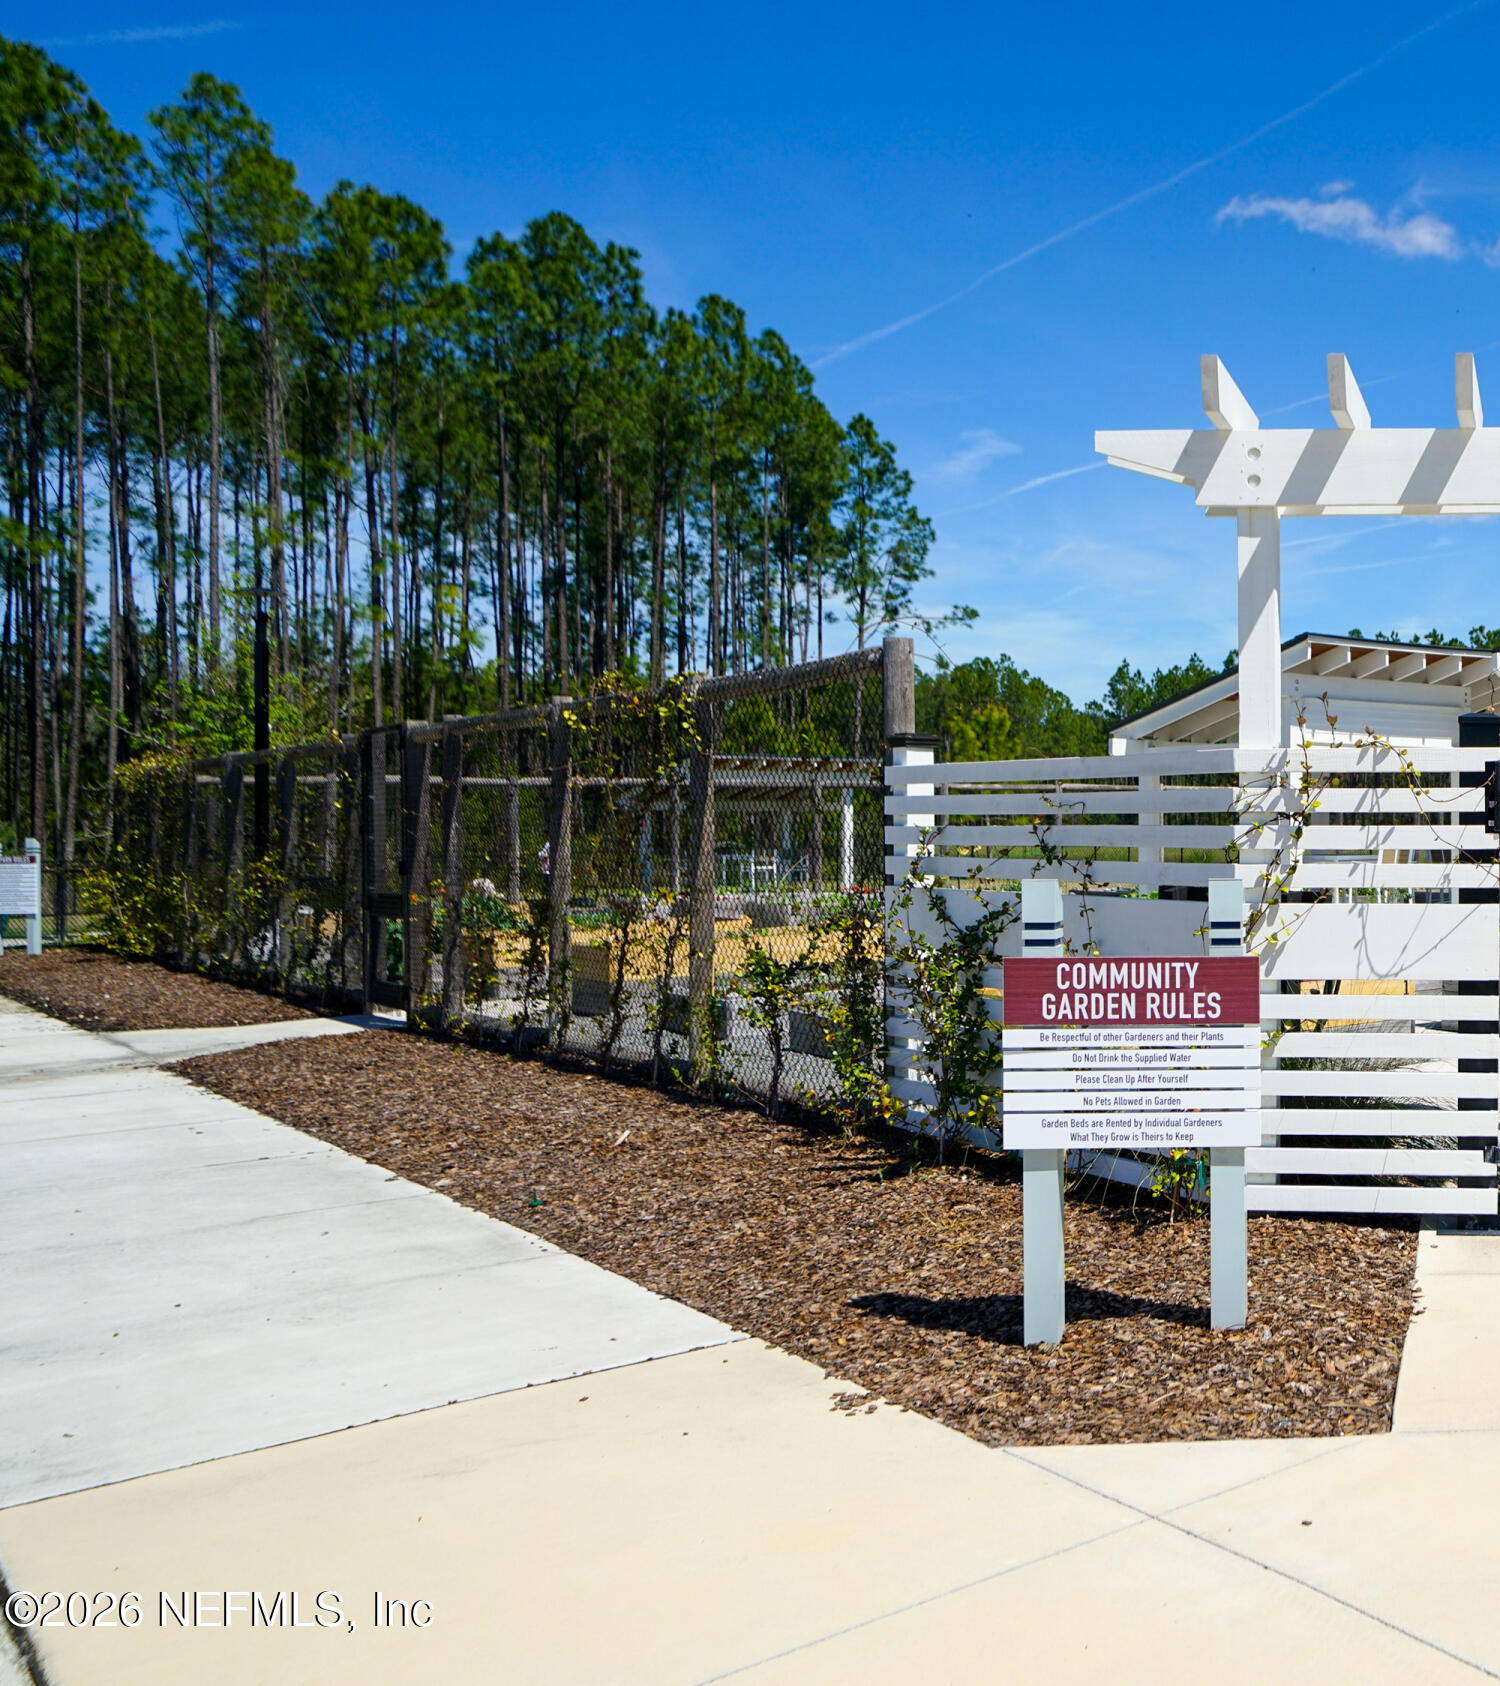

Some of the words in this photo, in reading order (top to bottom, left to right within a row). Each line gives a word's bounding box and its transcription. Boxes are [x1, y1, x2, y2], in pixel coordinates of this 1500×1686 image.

[1056, 962, 1200, 990] COMMUNITY
[1041, 992, 1136, 1020] GARDEN
[1146, 991, 1222, 1020] RULES
[1040, 1033, 1050, 1042] Be
[1051, 1033, 1092, 1044] Respectful
[1093, 1033, 1101, 1042] of
[1103, 1033, 1123, 1042] other
[1125, 1033, 1163, 1042] Gardeners
[1165, 1033, 1180, 1041] and
[1181, 1032, 1199, 1041] their
[1201, 1032, 1224, 1041] Plants
[1072, 1054, 1082, 1063] Do
[1084, 1054, 1097, 1063] Not
[1098, 1054, 1119, 1063] Drink
[1121, 1053, 1133, 1062] the
[1134, 1053, 1168, 1064] Supplied
[1169, 1053, 1192, 1062] Water
[1075, 1075, 1100, 1084] Please
[1102, 1075, 1124, 1084] Clean
[1125, 1075, 1135, 1086] Up
[1137, 1074, 1156, 1083] After
[1157, 1074, 1189, 1083] Yourself
[1083, 1097, 1093, 1106] No
[1095, 1097, 1112, 1106] Pets
[1113, 1097, 1143, 1106] Allowed
[1145, 1097, 1152, 1105] in
[1154, 1096, 1181, 1105] Garden
[1041, 1119, 1068, 1128] Garden
[1071, 1119, 1089, 1128] Beds
[1105, 1119, 1132, 1128] Rented
[1134, 1118, 1143, 1130] by
[1145, 1118, 1182, 1127] Individual
[1183, 1118, 1223, 1127] Gardeners
[1070, 1133, 1090, 1142] What
[1091, 1133, 1109, 1144] They
[1110, 1133, 1130, 1142] Grow
[1132, 1133, 1139, 1141] is
[1141, 1132, 1164, 1141] Theirs
[1166, 1132, 1174, 1141] to
[1175, 1132, 1194, 1143] Keep
